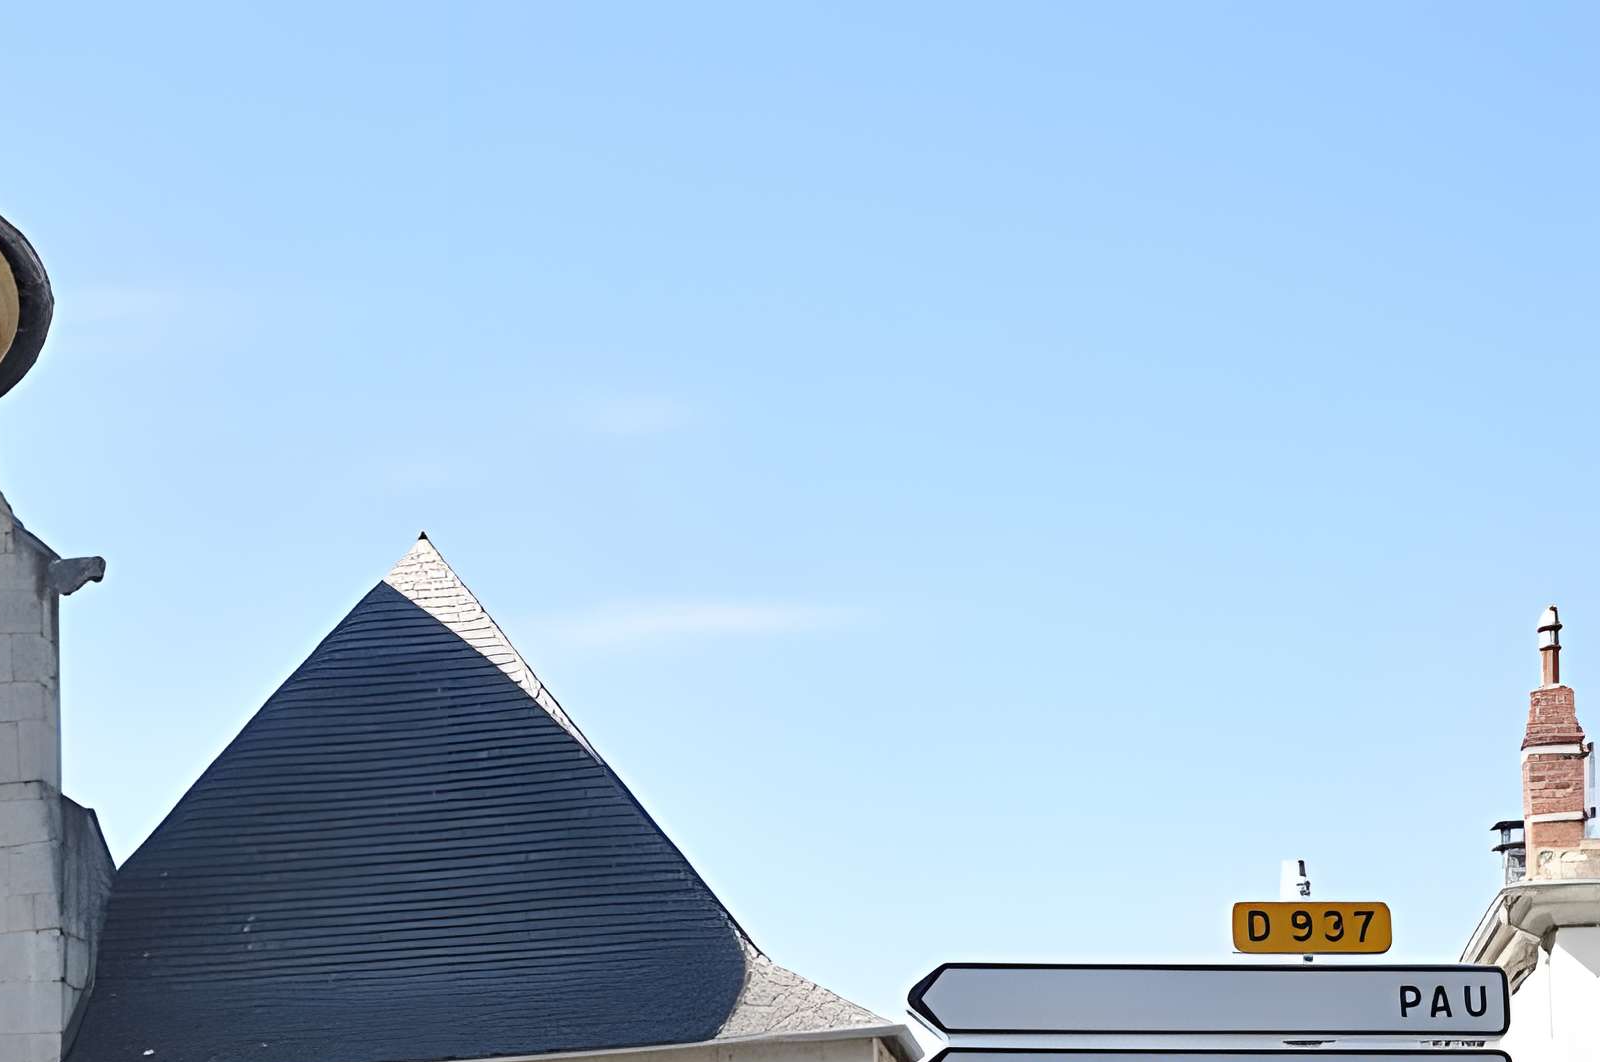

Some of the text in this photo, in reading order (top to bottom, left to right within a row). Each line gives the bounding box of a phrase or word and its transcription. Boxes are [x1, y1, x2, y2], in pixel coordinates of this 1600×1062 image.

[1247, 909, 1376, 944] D 937
[1399, 985, 1488, 1018] PAU
